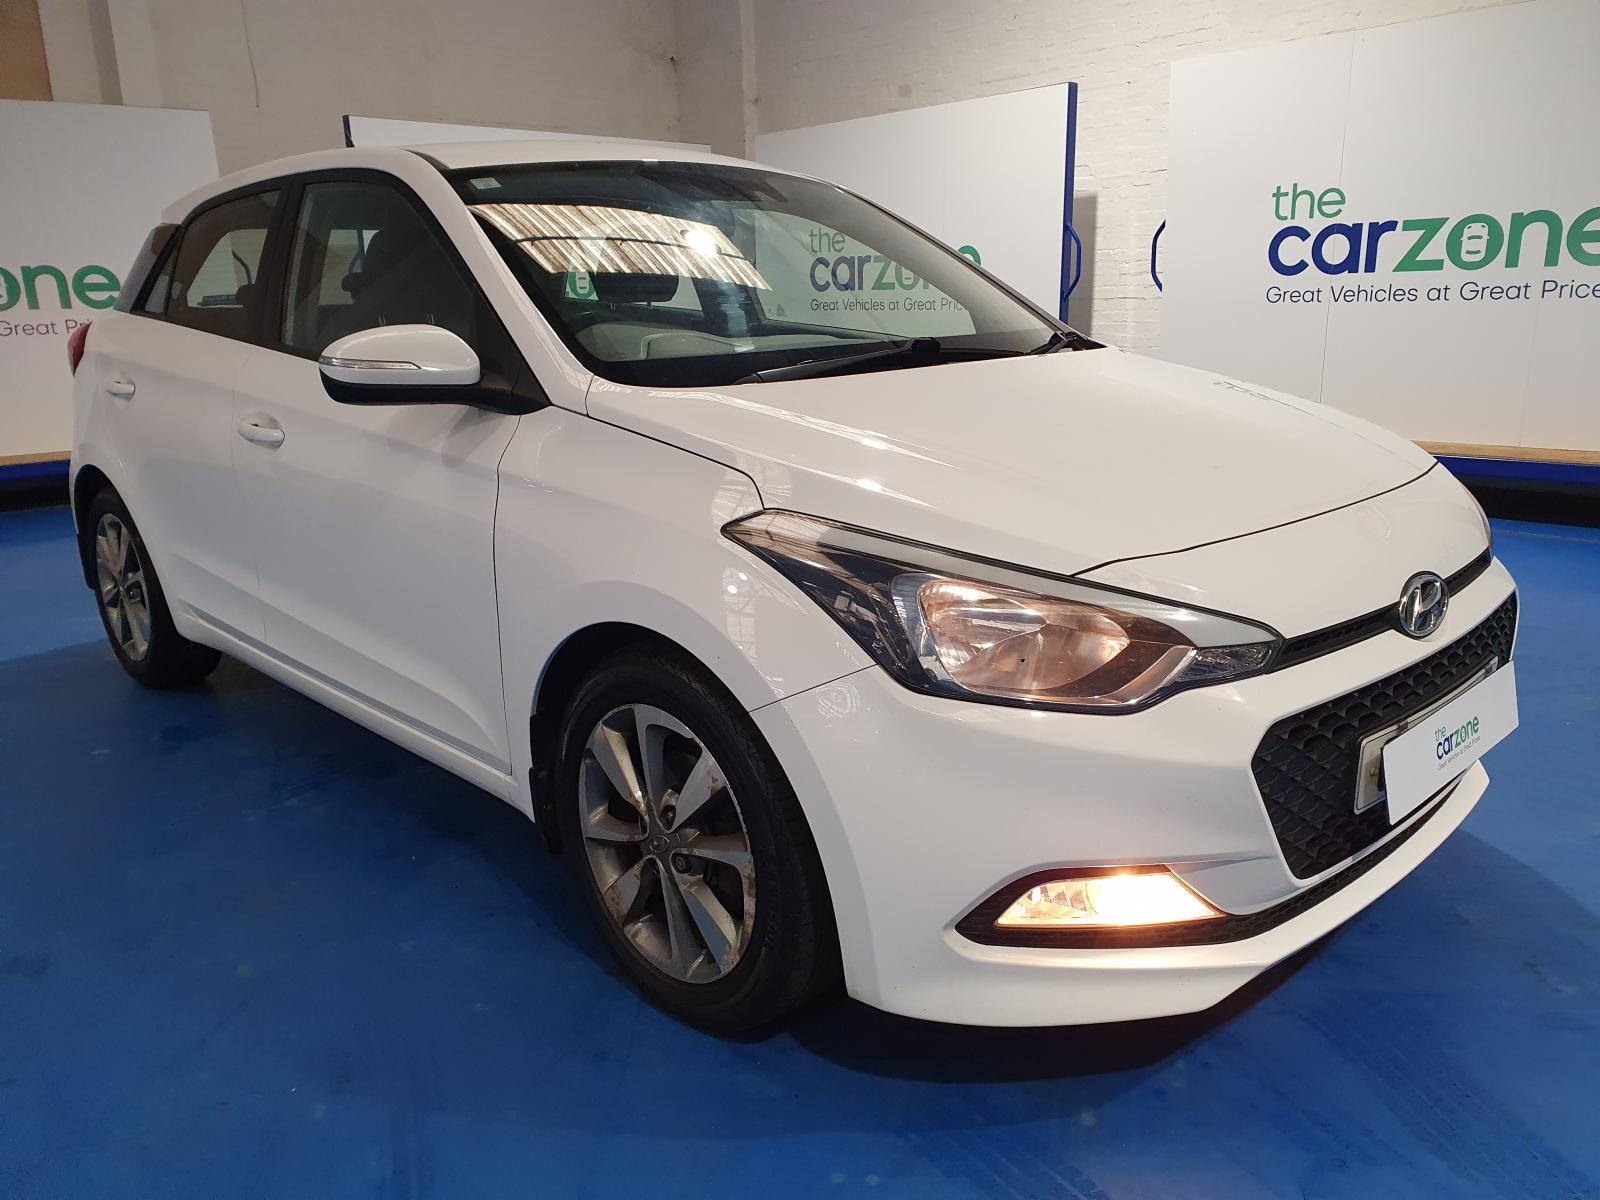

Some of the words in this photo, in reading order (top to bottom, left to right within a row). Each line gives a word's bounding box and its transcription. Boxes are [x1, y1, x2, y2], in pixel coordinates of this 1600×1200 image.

[1272, 183, 1346, 220] the
[809, 228, 845, 253] the
[1266, 285, 1322, 303] Great
[1330, 283, 1418, 302] Vehicles
[1426, 284, 1450, 301] at
[1459, 281, 1531, 301] Great
[1541, 280, 1600, 299] Price
[810, 299, 839, 311] Great
[842, 298, 885, 311] Vehicles
[888, 299, 900, 311] at
[903, 298, 936, 311] Great
[941, 298, 966, 311] Pric
[1437, 716, 1479, 760] carzone
